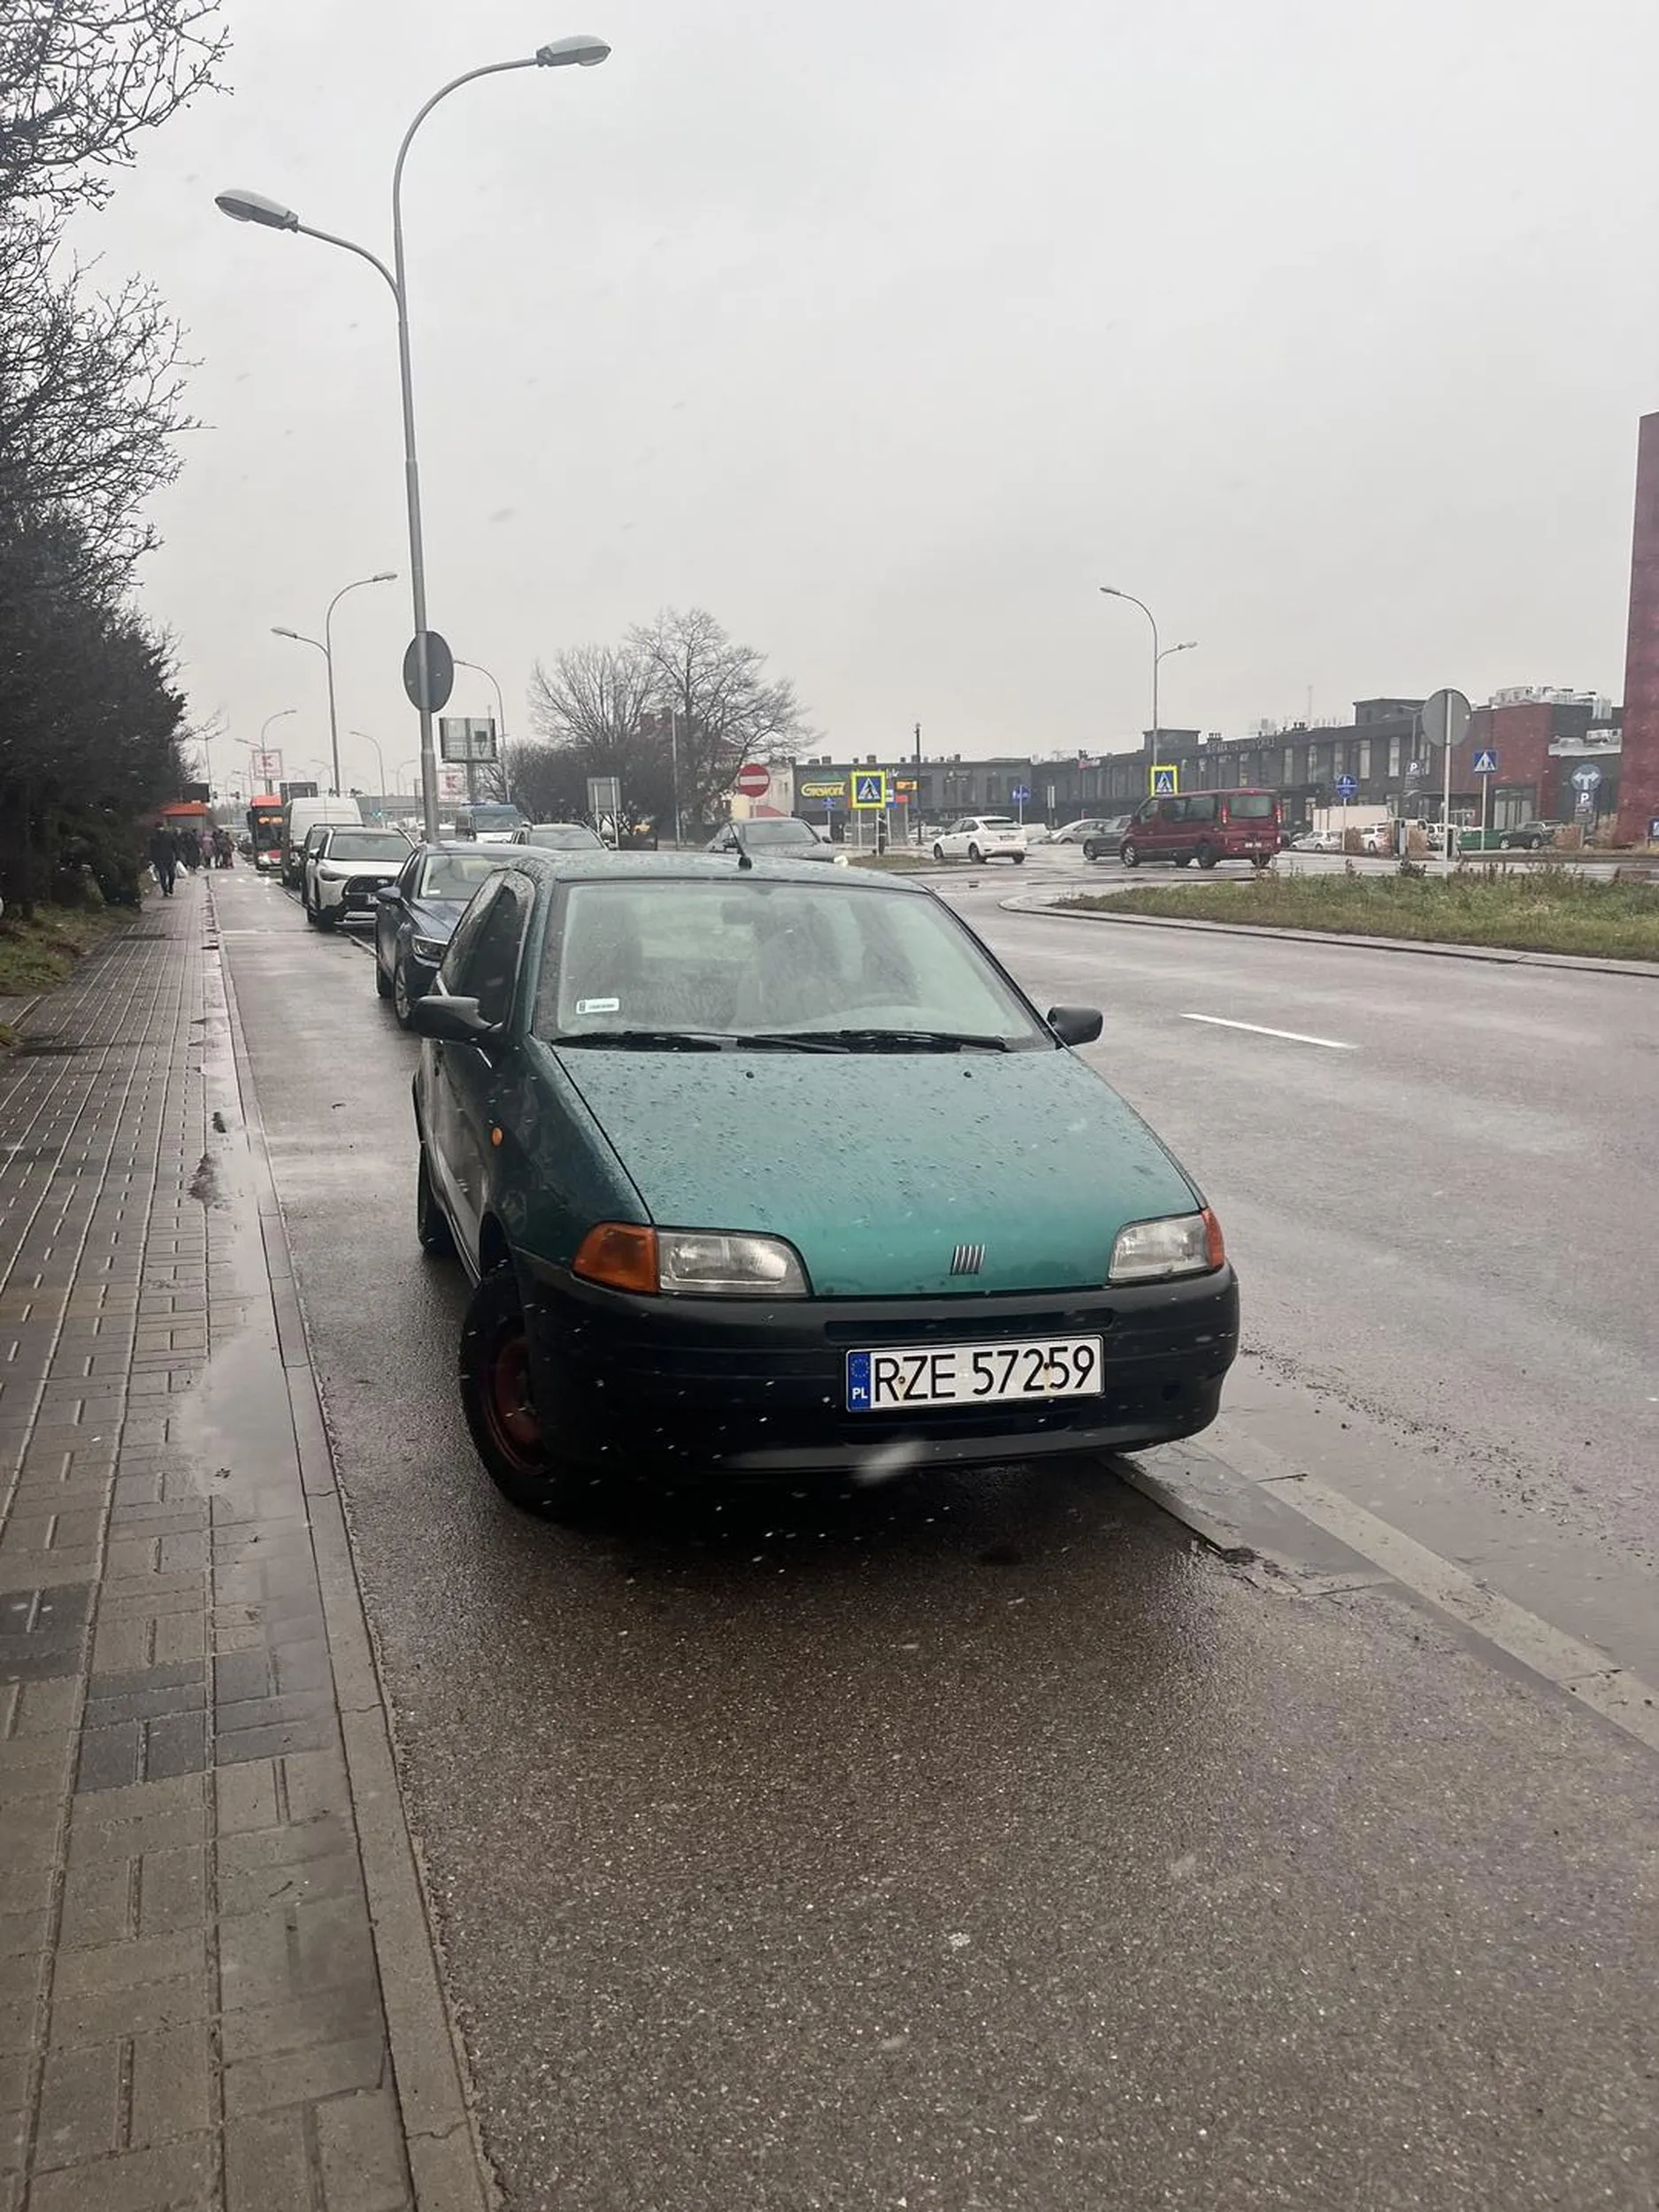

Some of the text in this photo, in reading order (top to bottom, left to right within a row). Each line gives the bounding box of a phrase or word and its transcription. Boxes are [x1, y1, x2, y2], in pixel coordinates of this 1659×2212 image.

[1580, 792, 1589, 803] P
[874, 1345, 1095, 1402] RZE 57259
[852, 1386, 868, 1400] PL
